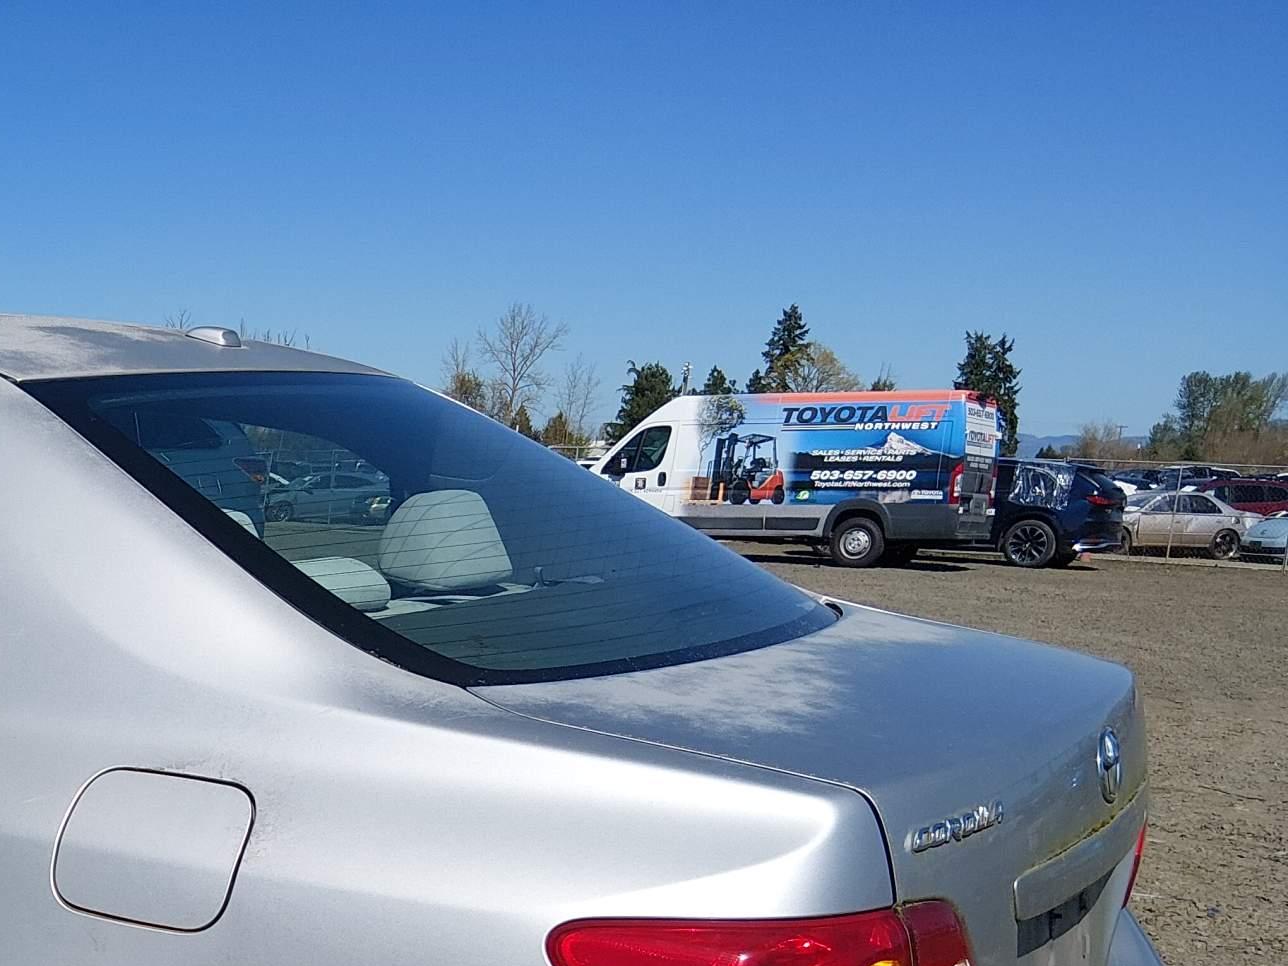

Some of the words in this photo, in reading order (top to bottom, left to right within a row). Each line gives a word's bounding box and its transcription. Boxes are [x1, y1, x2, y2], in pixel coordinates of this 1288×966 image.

[854, 421, 938, 431] NORTHWEST
[823, 455, 859, 463] LEASES
[810, 469, 918, 481] 503-657-6900
[911, 800, 1005, 853] COROLLA
